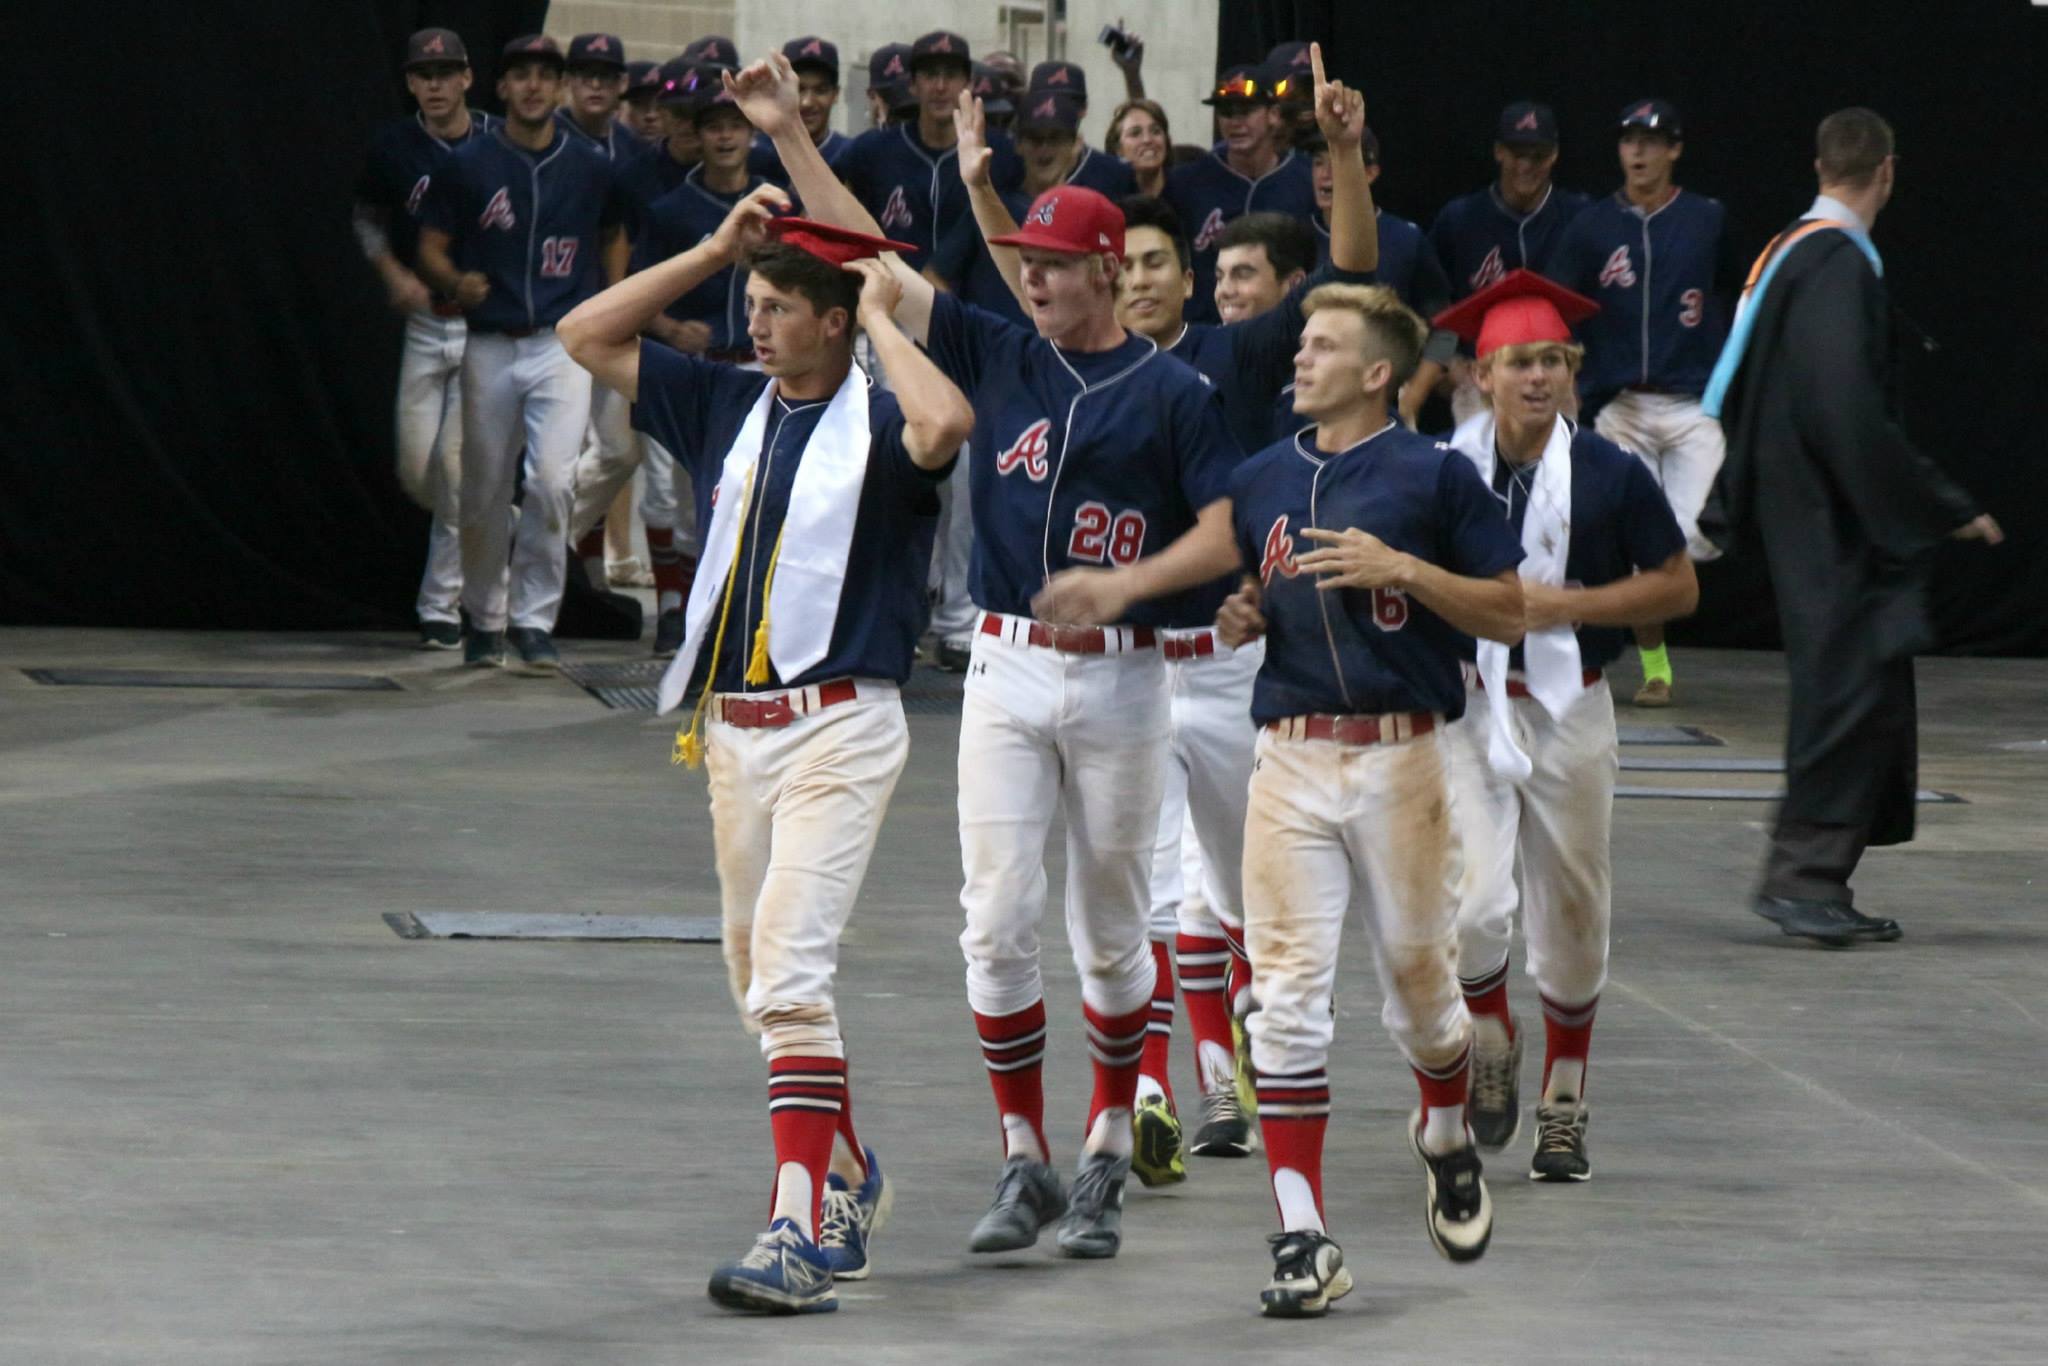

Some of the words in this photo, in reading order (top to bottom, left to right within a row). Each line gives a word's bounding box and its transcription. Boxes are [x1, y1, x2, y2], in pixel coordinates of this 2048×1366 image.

[479, 186, 515, 230] A
[542, 237, 577, 277] 17
[1599, 245, 1635, 288] A
[1679, 289, 1703, 327] 3
[997, 418, 1051, 482] A
[1068, 501, 1145, 566] 28
[1260, 515, 1299, 588] A
[1372, 588, 1407, 630] 6
